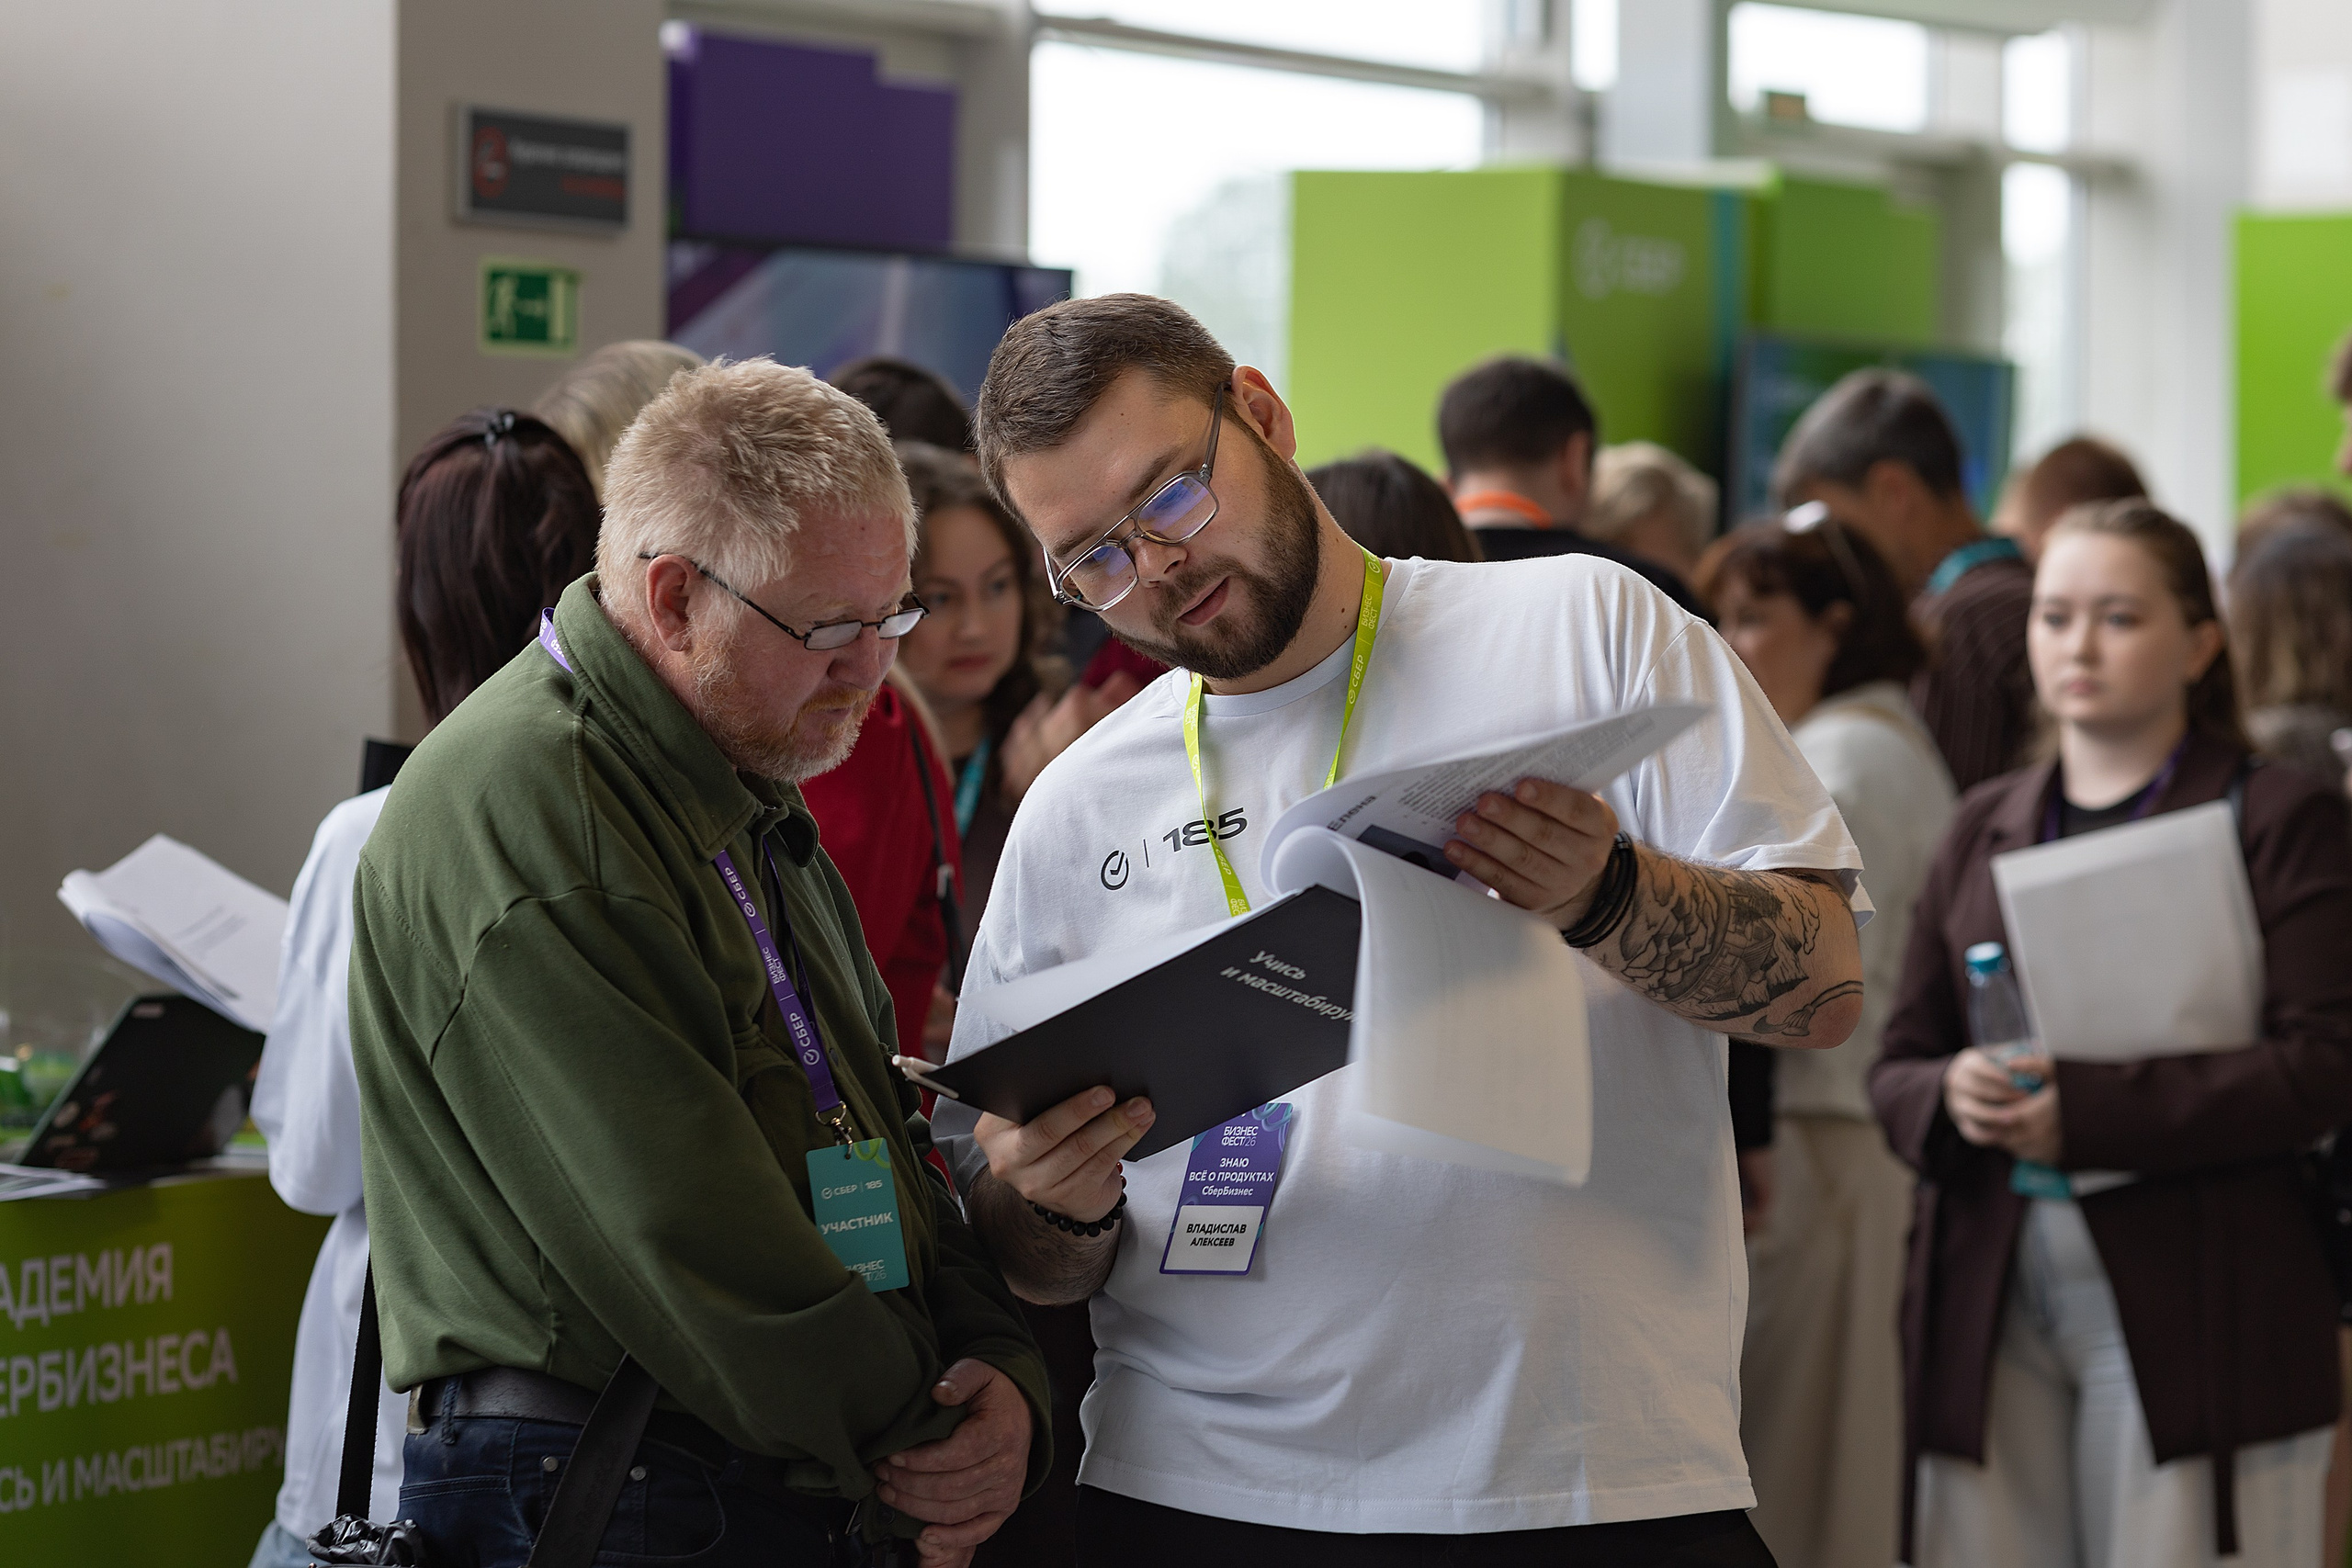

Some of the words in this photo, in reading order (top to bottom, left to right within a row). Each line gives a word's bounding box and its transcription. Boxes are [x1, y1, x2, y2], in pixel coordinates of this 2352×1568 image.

[1361, 594, 1374, 626] БИЗНЕС
[1369, 608, 1378, 629] ФЕСТ
[1351, 654, 1364, 687] СБЕР
[1162, 807, 1248, 852] 185
[724, 867, 746, 900] СБЕР
[762, 946, 781, 985] БИЗНЕС
[772, 957, 786, 982] ФЕСТ
[1220, 966, 1241, 978] и
[1249, 950, 1306, 980] Учись
[789, 1012, 811, 1047] СБЕР
[1221, 1136, 1257, 1146] ФЕСТ/26
[1223, 1125, 1259, 1136] БИЗНЕС
[1219, 1157, 1250, 1168] ЗНАЮ
[833, 1184, 858, 1196] СБЕР
[865, 1179, 883, 1190] 185
[1188, 1169, 1207, 1182] ВСЁ
[1208, 1172, 1216, 1181] О
[1216, 1171, 1275, 1184] ПРОДУКТАХ
[1202, 1185, 1254, 1198] СберБизнес
[820, 1212, 894, 1235] УЧАСТНИК
[1186, 1224, 1248, 1235] ВЛАДИСЛАВ
[1190, 1237, 1236, 1247] АЛЕКСЕЕВ
[41, 1456, 68, 1506] И
